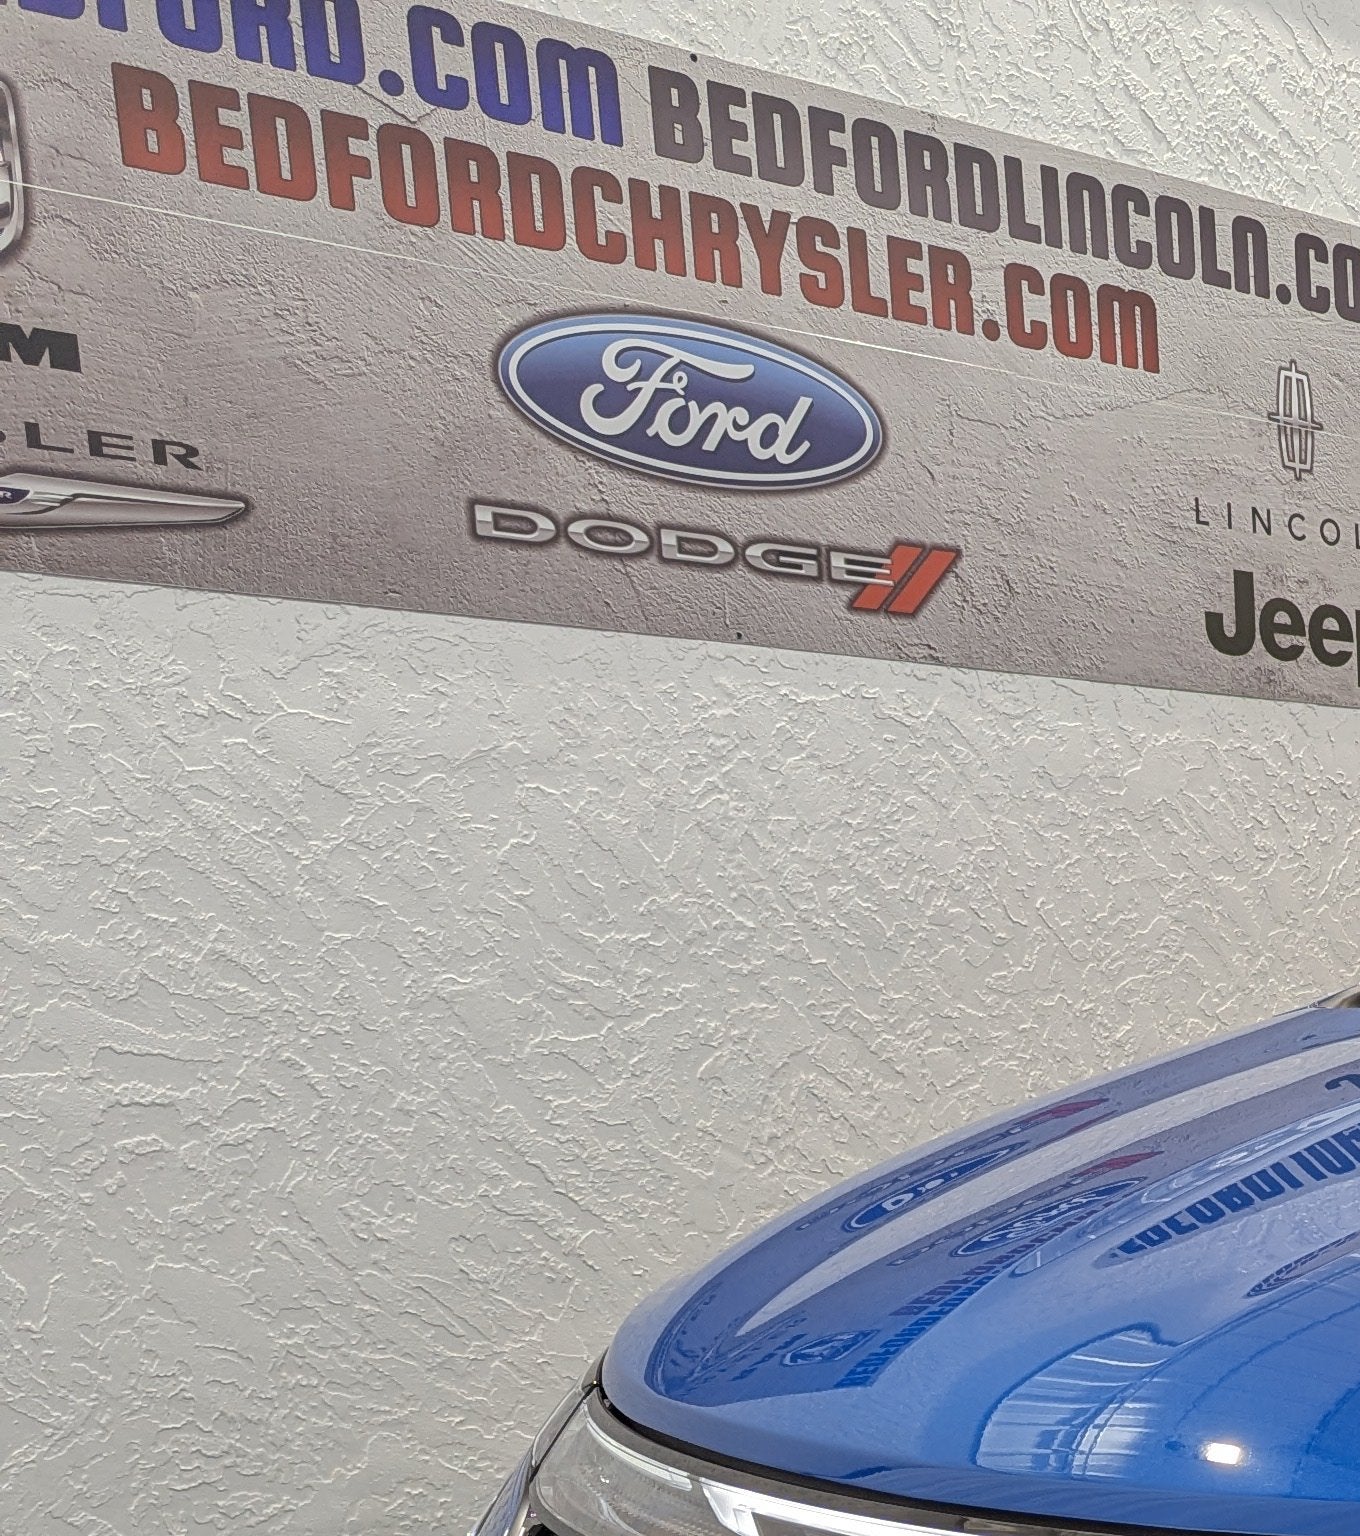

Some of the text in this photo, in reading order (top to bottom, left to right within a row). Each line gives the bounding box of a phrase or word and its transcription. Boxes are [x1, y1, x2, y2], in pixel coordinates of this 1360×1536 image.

[111, 62, 1160, 374] BEDFORDCHRYSLER.COM
[580, 338, 814, 465] Ford
[473, 503, 896, 588] DODGE
